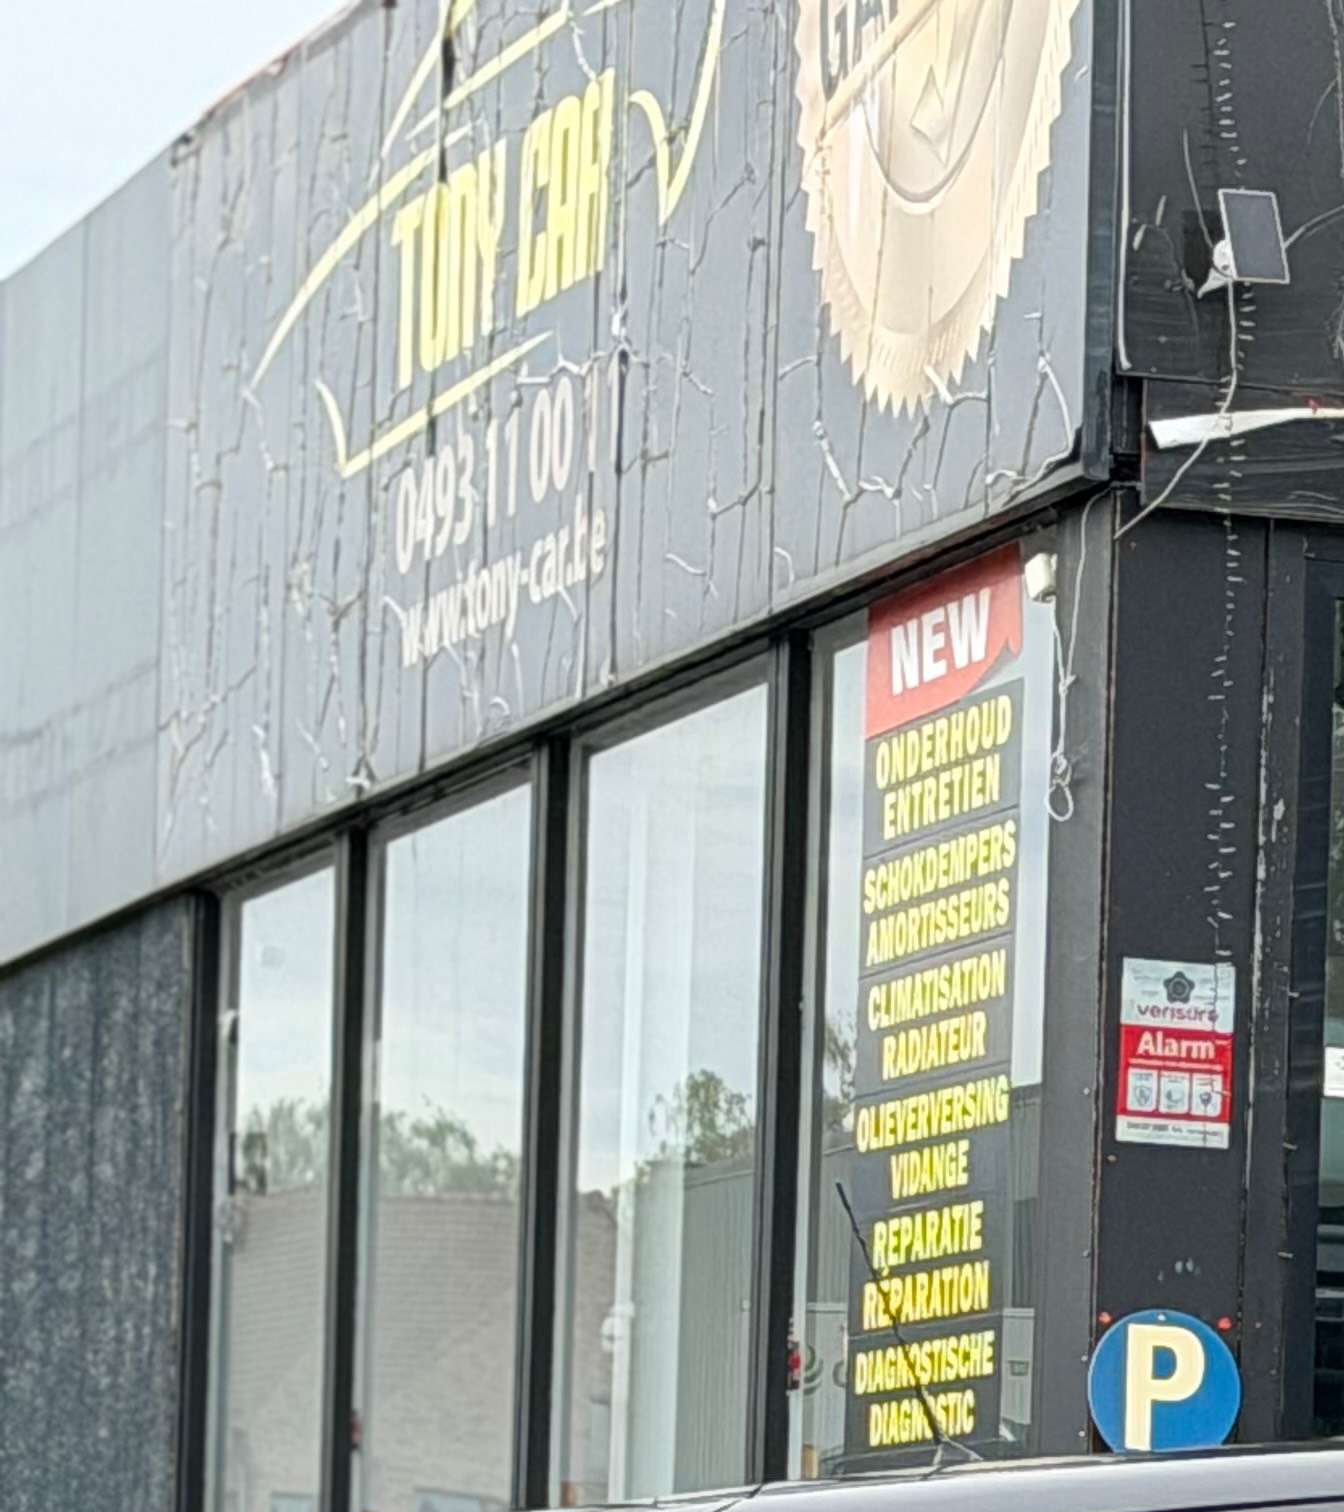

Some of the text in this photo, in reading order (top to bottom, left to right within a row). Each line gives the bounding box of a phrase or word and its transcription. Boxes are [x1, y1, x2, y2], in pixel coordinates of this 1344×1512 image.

[391, 66, 616, 391] TONY CAR
[396, 432, 475, 574] 0493
[486, 408, 520, 528] 11
[529, 376, 574, 503] 00
[890, 588, 992, 696] NEW
[875, 694, 1012, 790] ONDERHOUD
[883, 753, 1001, 840] ENTRETIEN
[864, 818, 1017, 914] SCHOKDEMPERS
[865, 877, 1010, 967] AMORTISSEURS
[867, 948, 1007, 1032] CLIMATISATION
[882, 1010, 987, 1081] RADIATEUR
[1135, 1030, 1217, 1060] Alarm
[856, 1074, 1010, 1153] OLIEVERVERSING
[890, 1138, 970, 1200] VIDANGE
[872, 1200, 984, 1272] REPARATIE
[854, 1329, 996, 1395] DIAGNOSTISCHE
[1124, 1322, 1206, 1452] P
